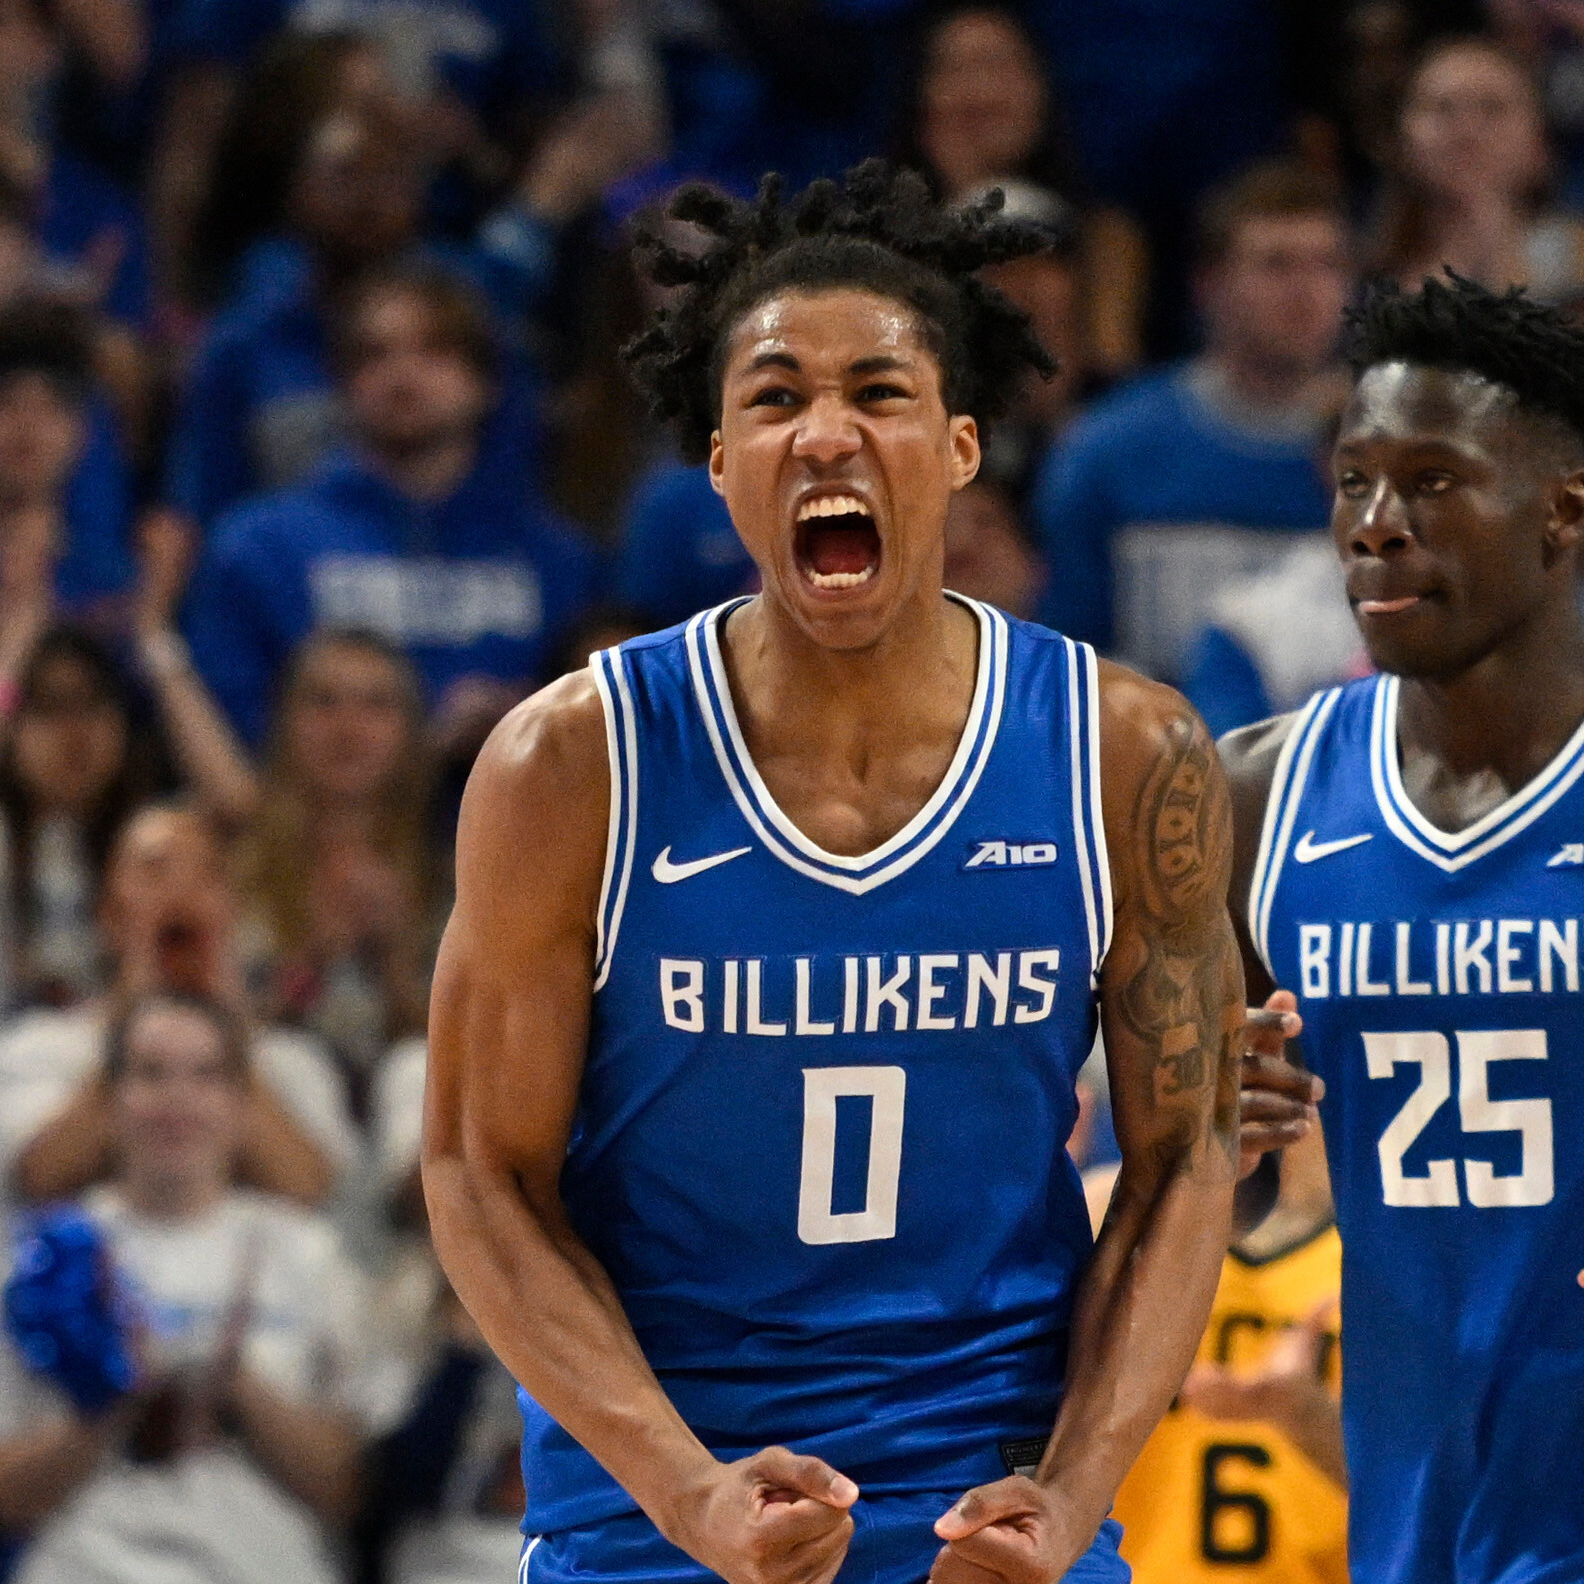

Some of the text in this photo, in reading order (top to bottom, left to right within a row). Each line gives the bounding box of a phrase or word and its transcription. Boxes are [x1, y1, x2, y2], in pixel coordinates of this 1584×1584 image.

[965, 841, 1058, 868] A10
[659, 948, 1061, 1038] BILLIKENS
[797, 1064, 907, 1246] 0
[1360, 1029, 1555, 1208] 25
[1199, 1441, 1273, 1567] 6
